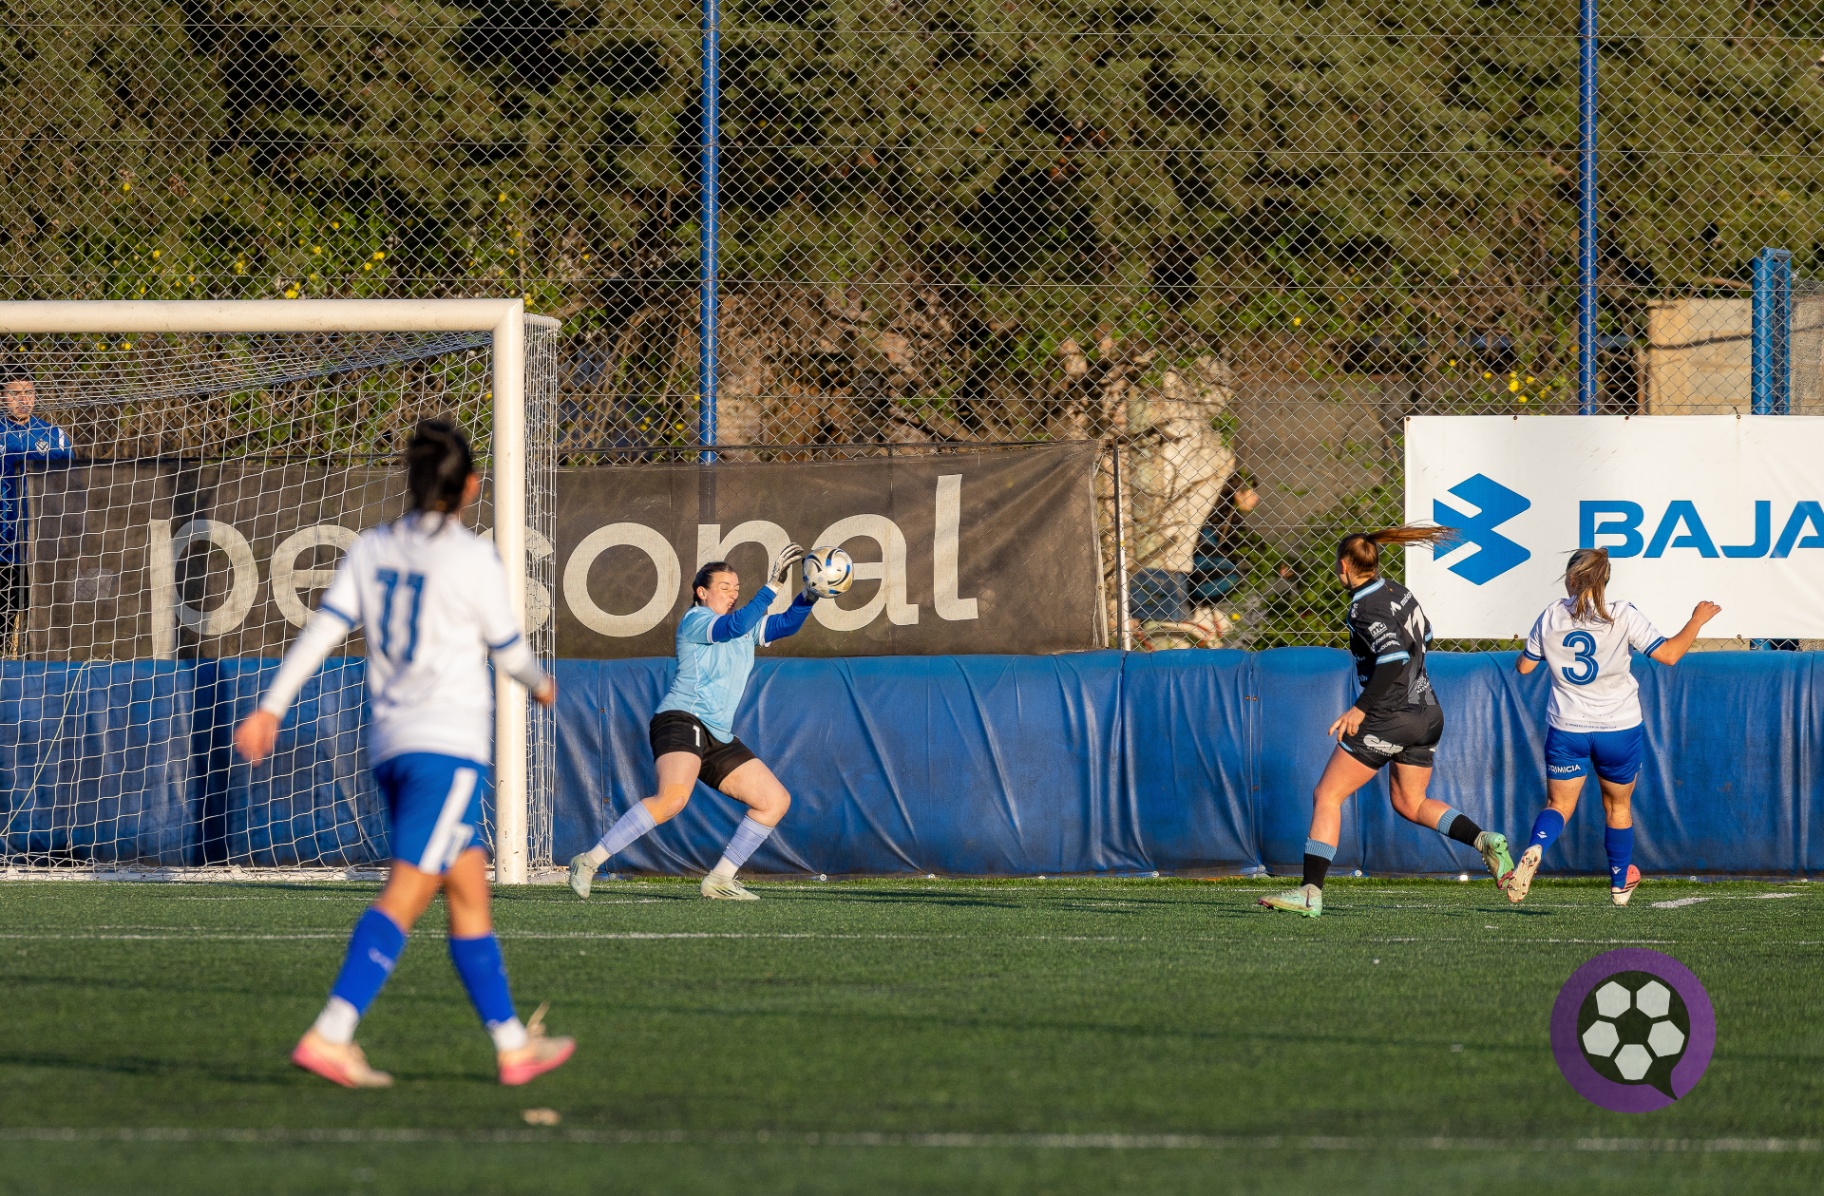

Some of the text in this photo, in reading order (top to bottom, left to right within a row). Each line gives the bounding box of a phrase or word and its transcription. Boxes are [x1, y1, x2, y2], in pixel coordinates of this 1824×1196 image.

[1579, 500, 1824, 558] BAJA
[149, 473, 979, 660] peonal
[374, 567, 425, 664] 11
[1561, 630, 1599, 686] 3
[692, 724, 701, 748] 1
